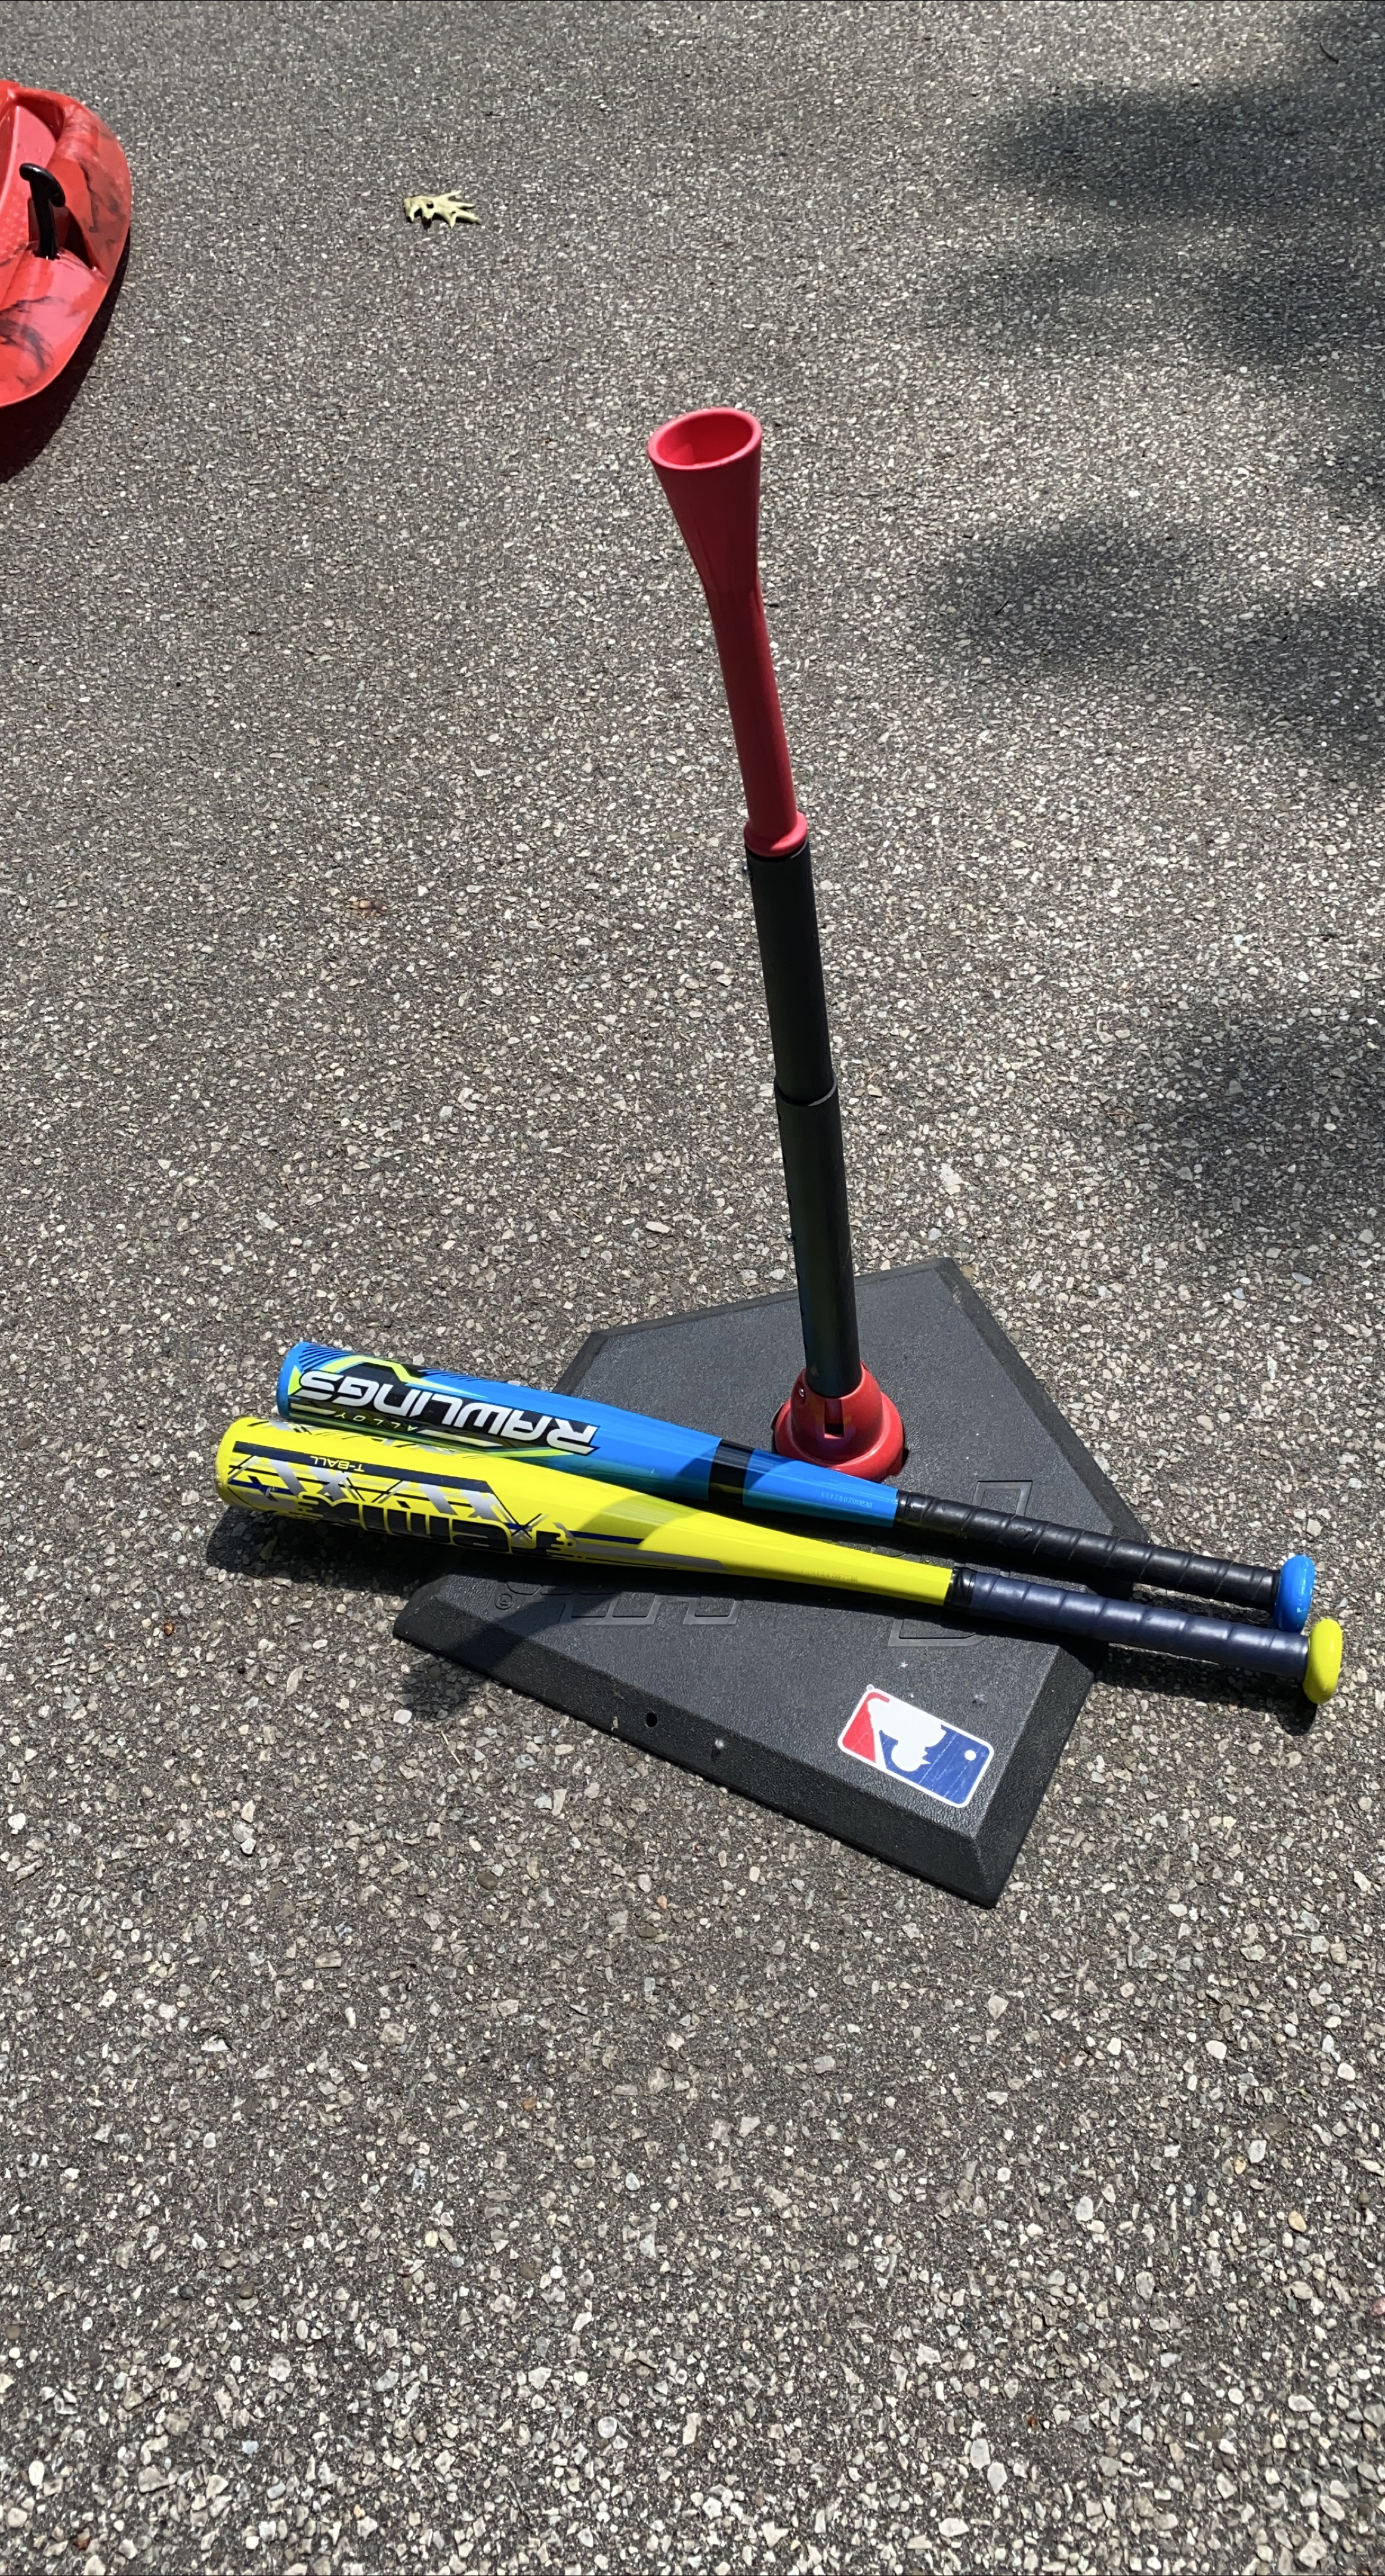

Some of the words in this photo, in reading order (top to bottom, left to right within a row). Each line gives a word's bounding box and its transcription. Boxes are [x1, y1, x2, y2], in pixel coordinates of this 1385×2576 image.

[299, 1371, 598, 1454] RAWLINGS
[334, 1411, 418, 1432] ALLOY
[310, 1456, 364, 1472] T-BALL
